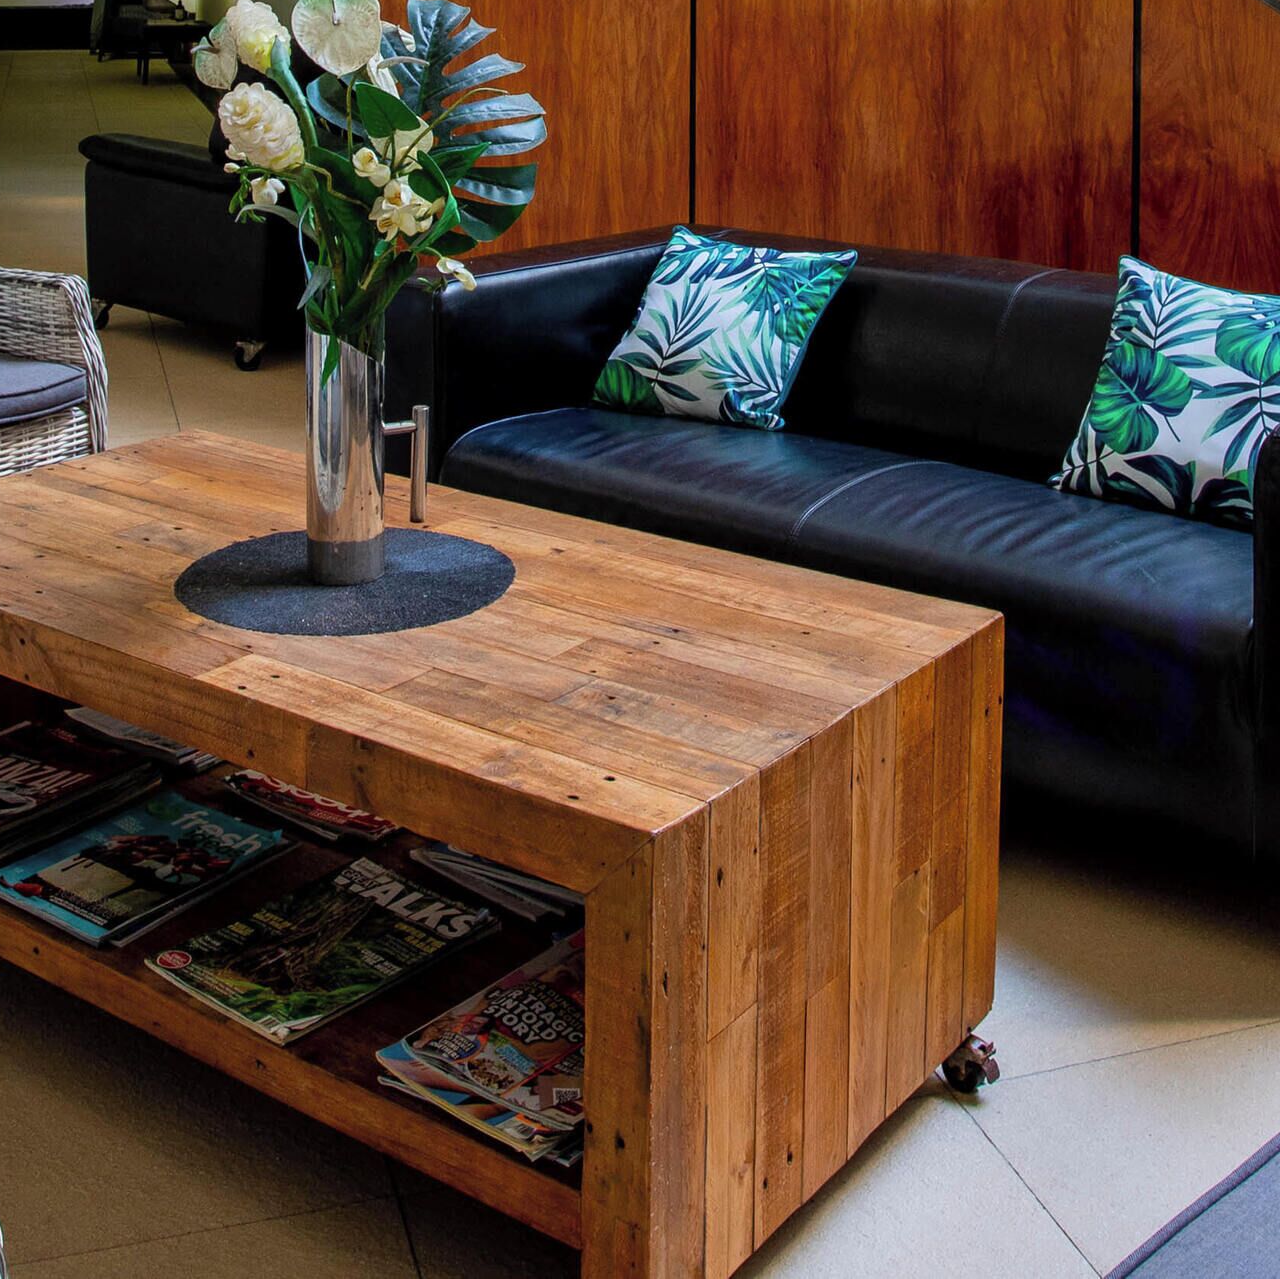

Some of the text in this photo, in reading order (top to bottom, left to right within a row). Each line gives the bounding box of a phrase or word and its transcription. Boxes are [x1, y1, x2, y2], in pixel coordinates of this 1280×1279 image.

[170, 810, 262, 857] fresh
[483, 1004, 541, 1044] STORY
[490, 997, 558, 1041] UNTOLD
[522, 993, 584, 1043] TRAGIC
